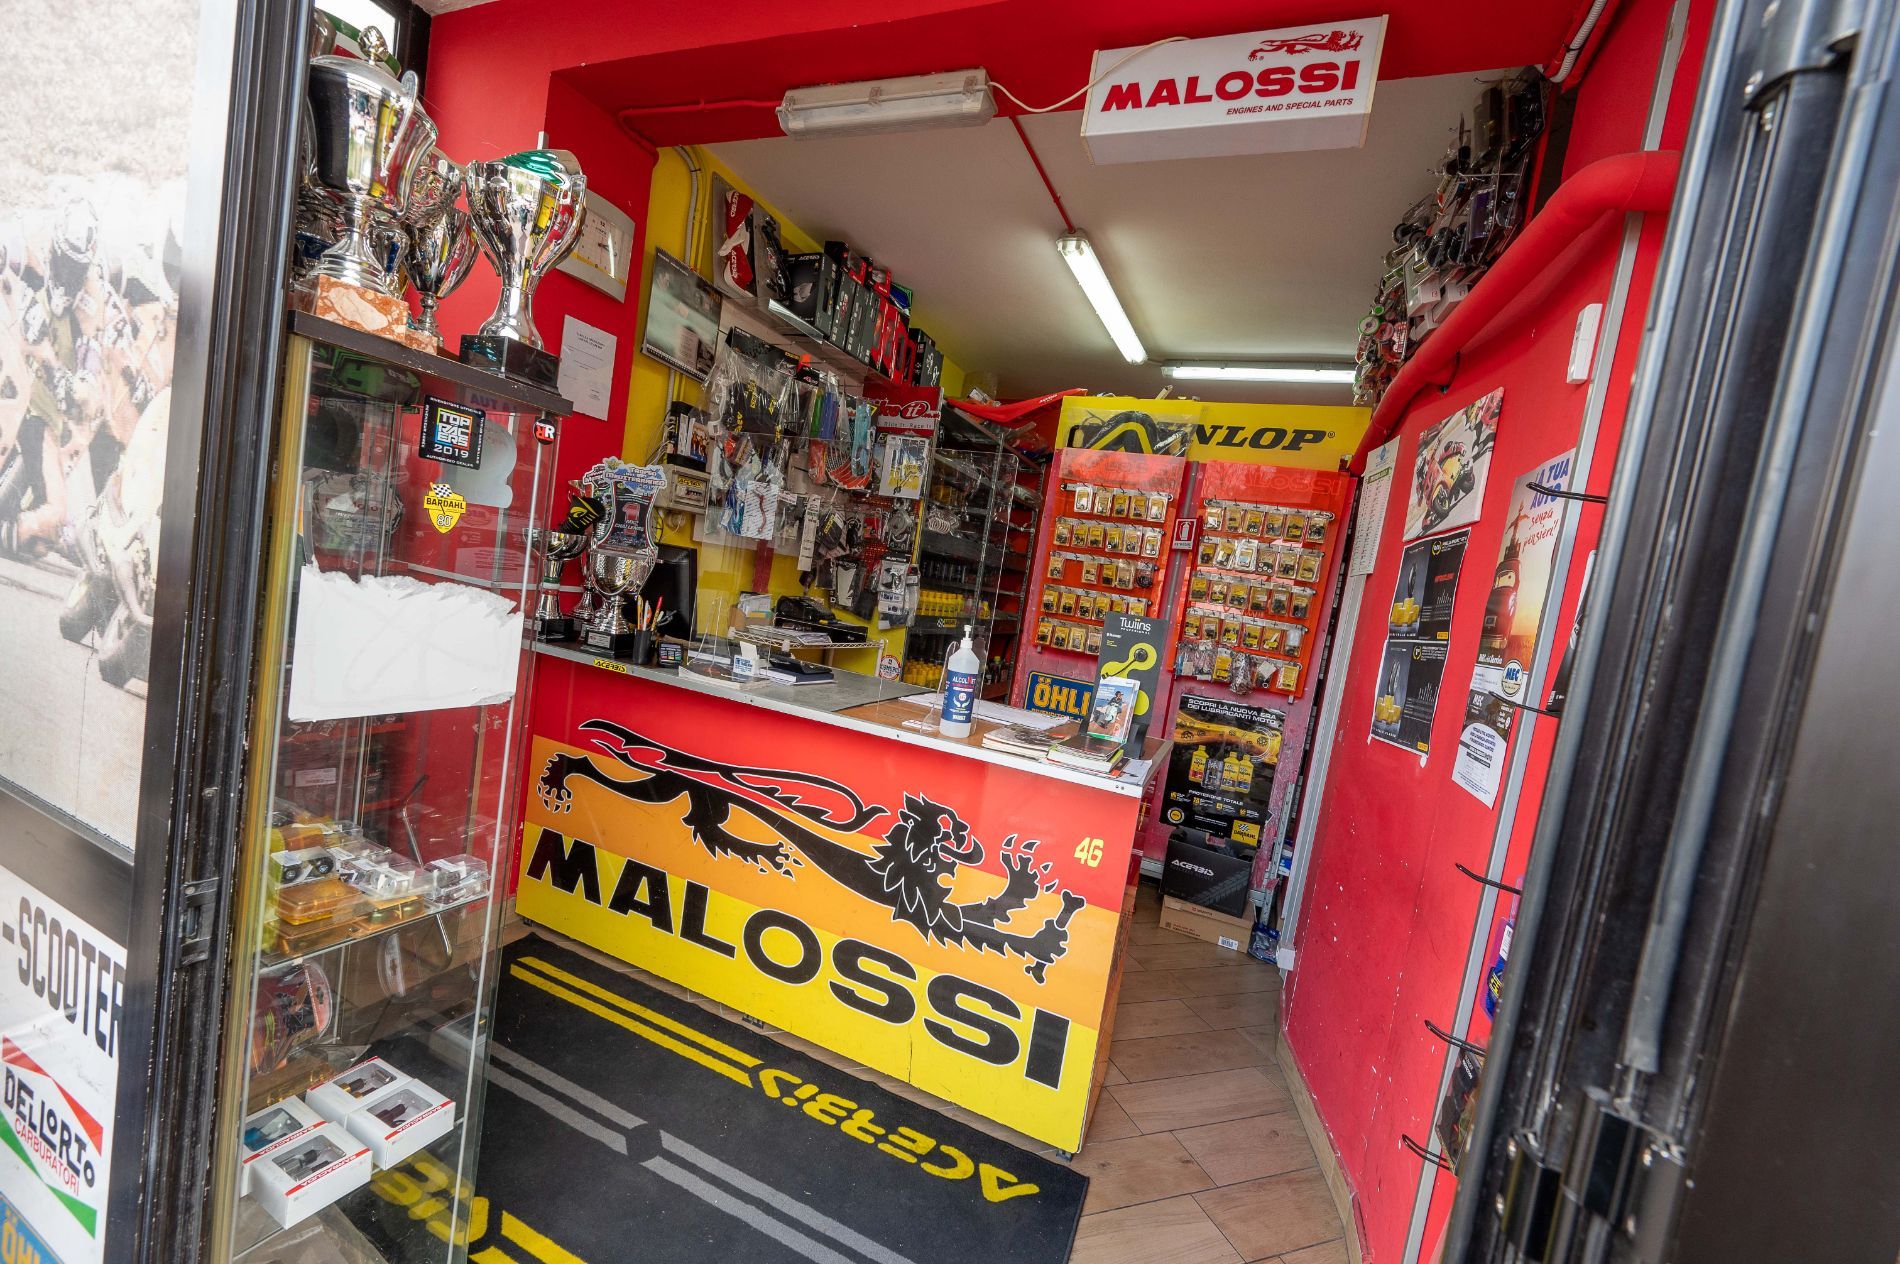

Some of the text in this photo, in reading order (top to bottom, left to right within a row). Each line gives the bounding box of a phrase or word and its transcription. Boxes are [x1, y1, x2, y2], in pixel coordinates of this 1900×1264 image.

[1101, 60, 1360, 112] MALOSSI
[1226, 98, 1354, 115] ENGINES AND SPECIAL PARTS
[440, 411, 471, 426] TOP
[433, 443, 469, 458] 2019
[1549, 457, 1570, 484] TUA
[426, 497, 464, 510] BARDAHL
[1120, 617, 1151, 632] Twiins
[1504, 667, 1520, 682] MEC
[1188, 699, 1216, 708] SCOPRI
[1230, 706, 1258, 716] NUOVA
[1200, 706, 1251, 721] LUBRIFICANTI
[1252, 716, 1276, 725] MOTO
[1074, 839, 1104, 868] 46
[1171, 859, 1214, 877] ACERBIS
[523, 827, 1072, 1092] MALOSSI
[759, 1067, 1041, 1202] ACERBIS
[14, 1118, 80, 1197] CARBURATORI
